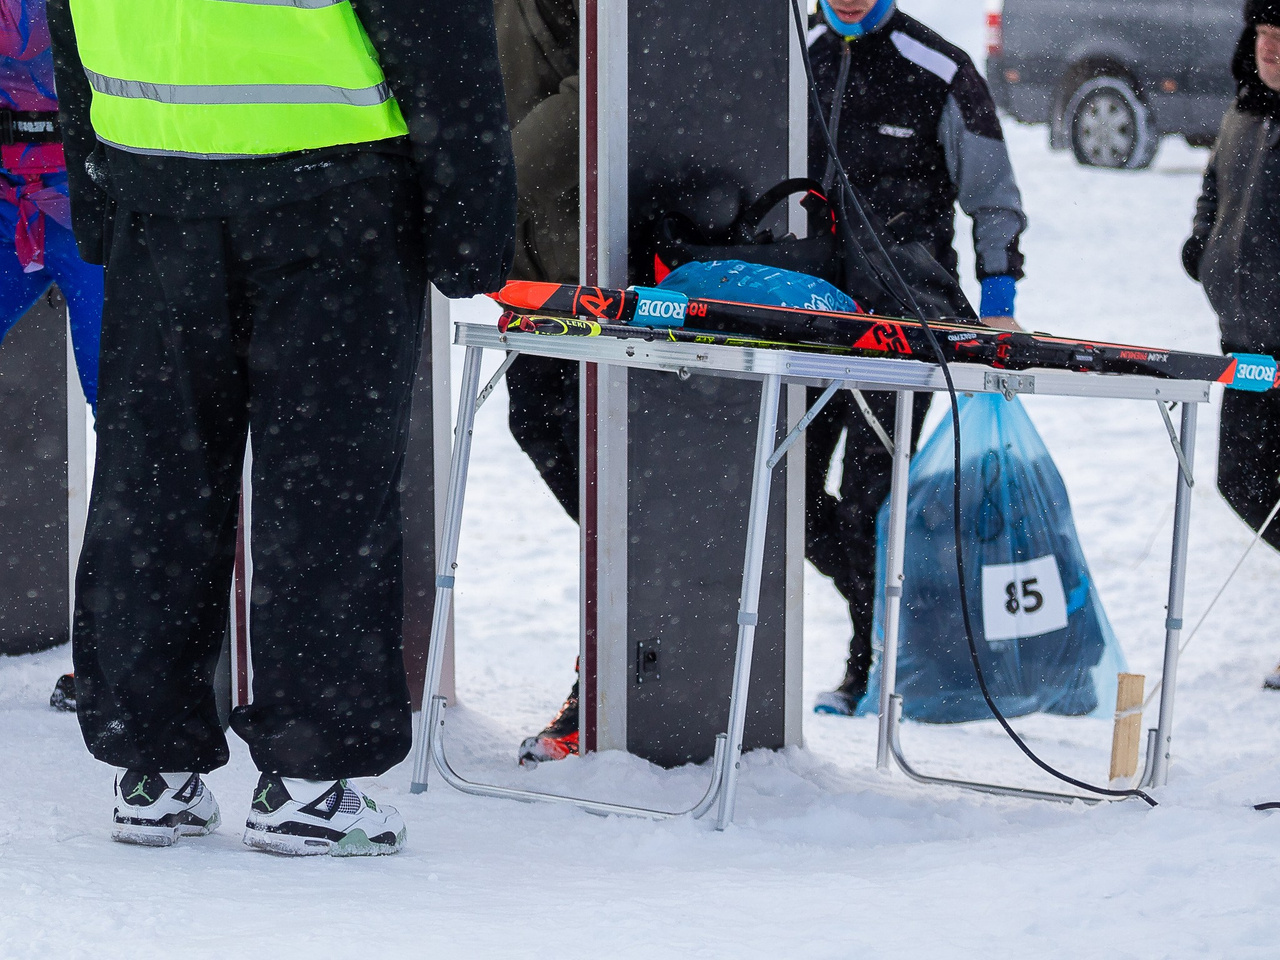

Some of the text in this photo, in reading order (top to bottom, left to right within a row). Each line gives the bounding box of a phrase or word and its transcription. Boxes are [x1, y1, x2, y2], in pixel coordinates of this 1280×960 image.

[638, 299, 687, 320] RODE
[1237, 363, 1276, 382] RODE
[1005, 577, 1044, 615] 85
